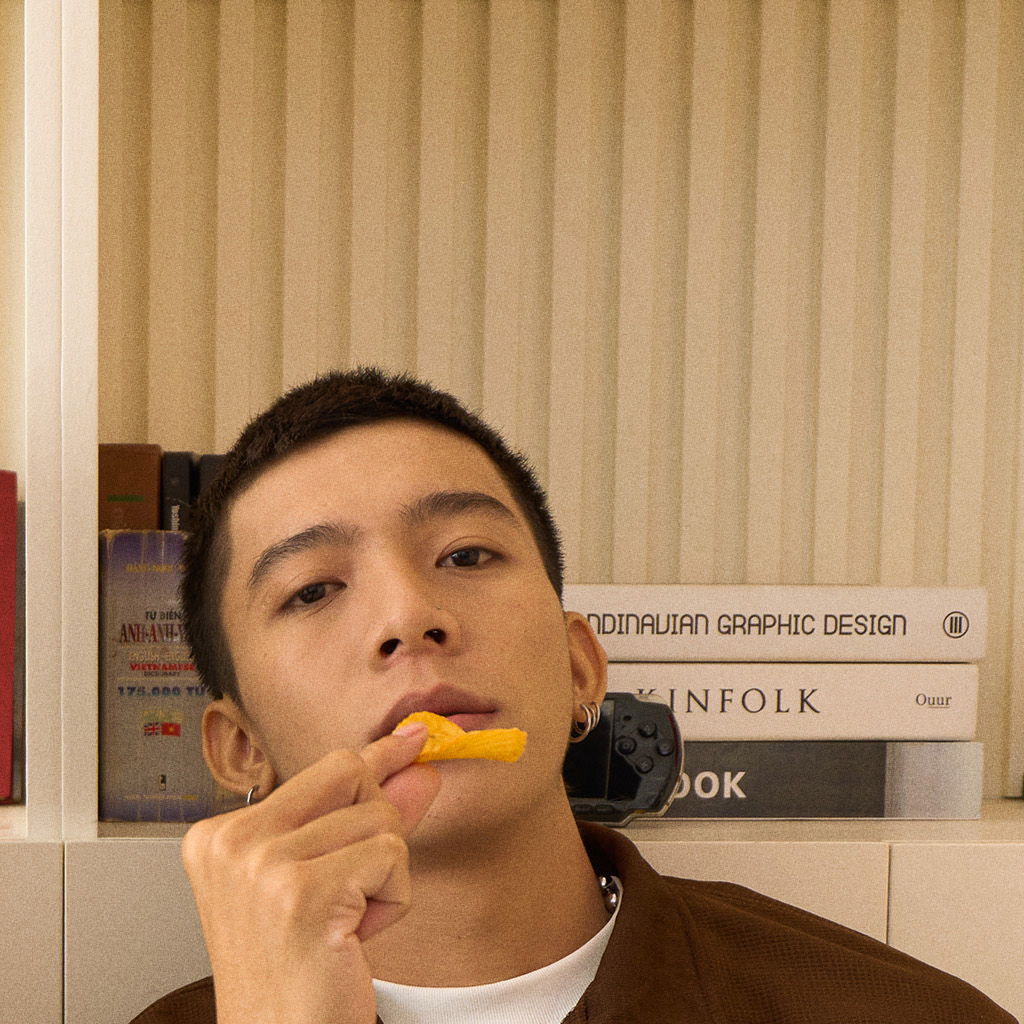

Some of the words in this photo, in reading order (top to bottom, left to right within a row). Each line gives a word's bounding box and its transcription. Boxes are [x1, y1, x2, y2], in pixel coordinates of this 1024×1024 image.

[587, 613, 709, 635] NDINAVIAN
[717, 613, 815, 636] GRAPHIC
[824, 613, 907, 636] DESIGN
[118, 685, 182, 697] 175.000
[915, 692, 953, 706] Ouur
[674, 770, 747, 799] OOK
